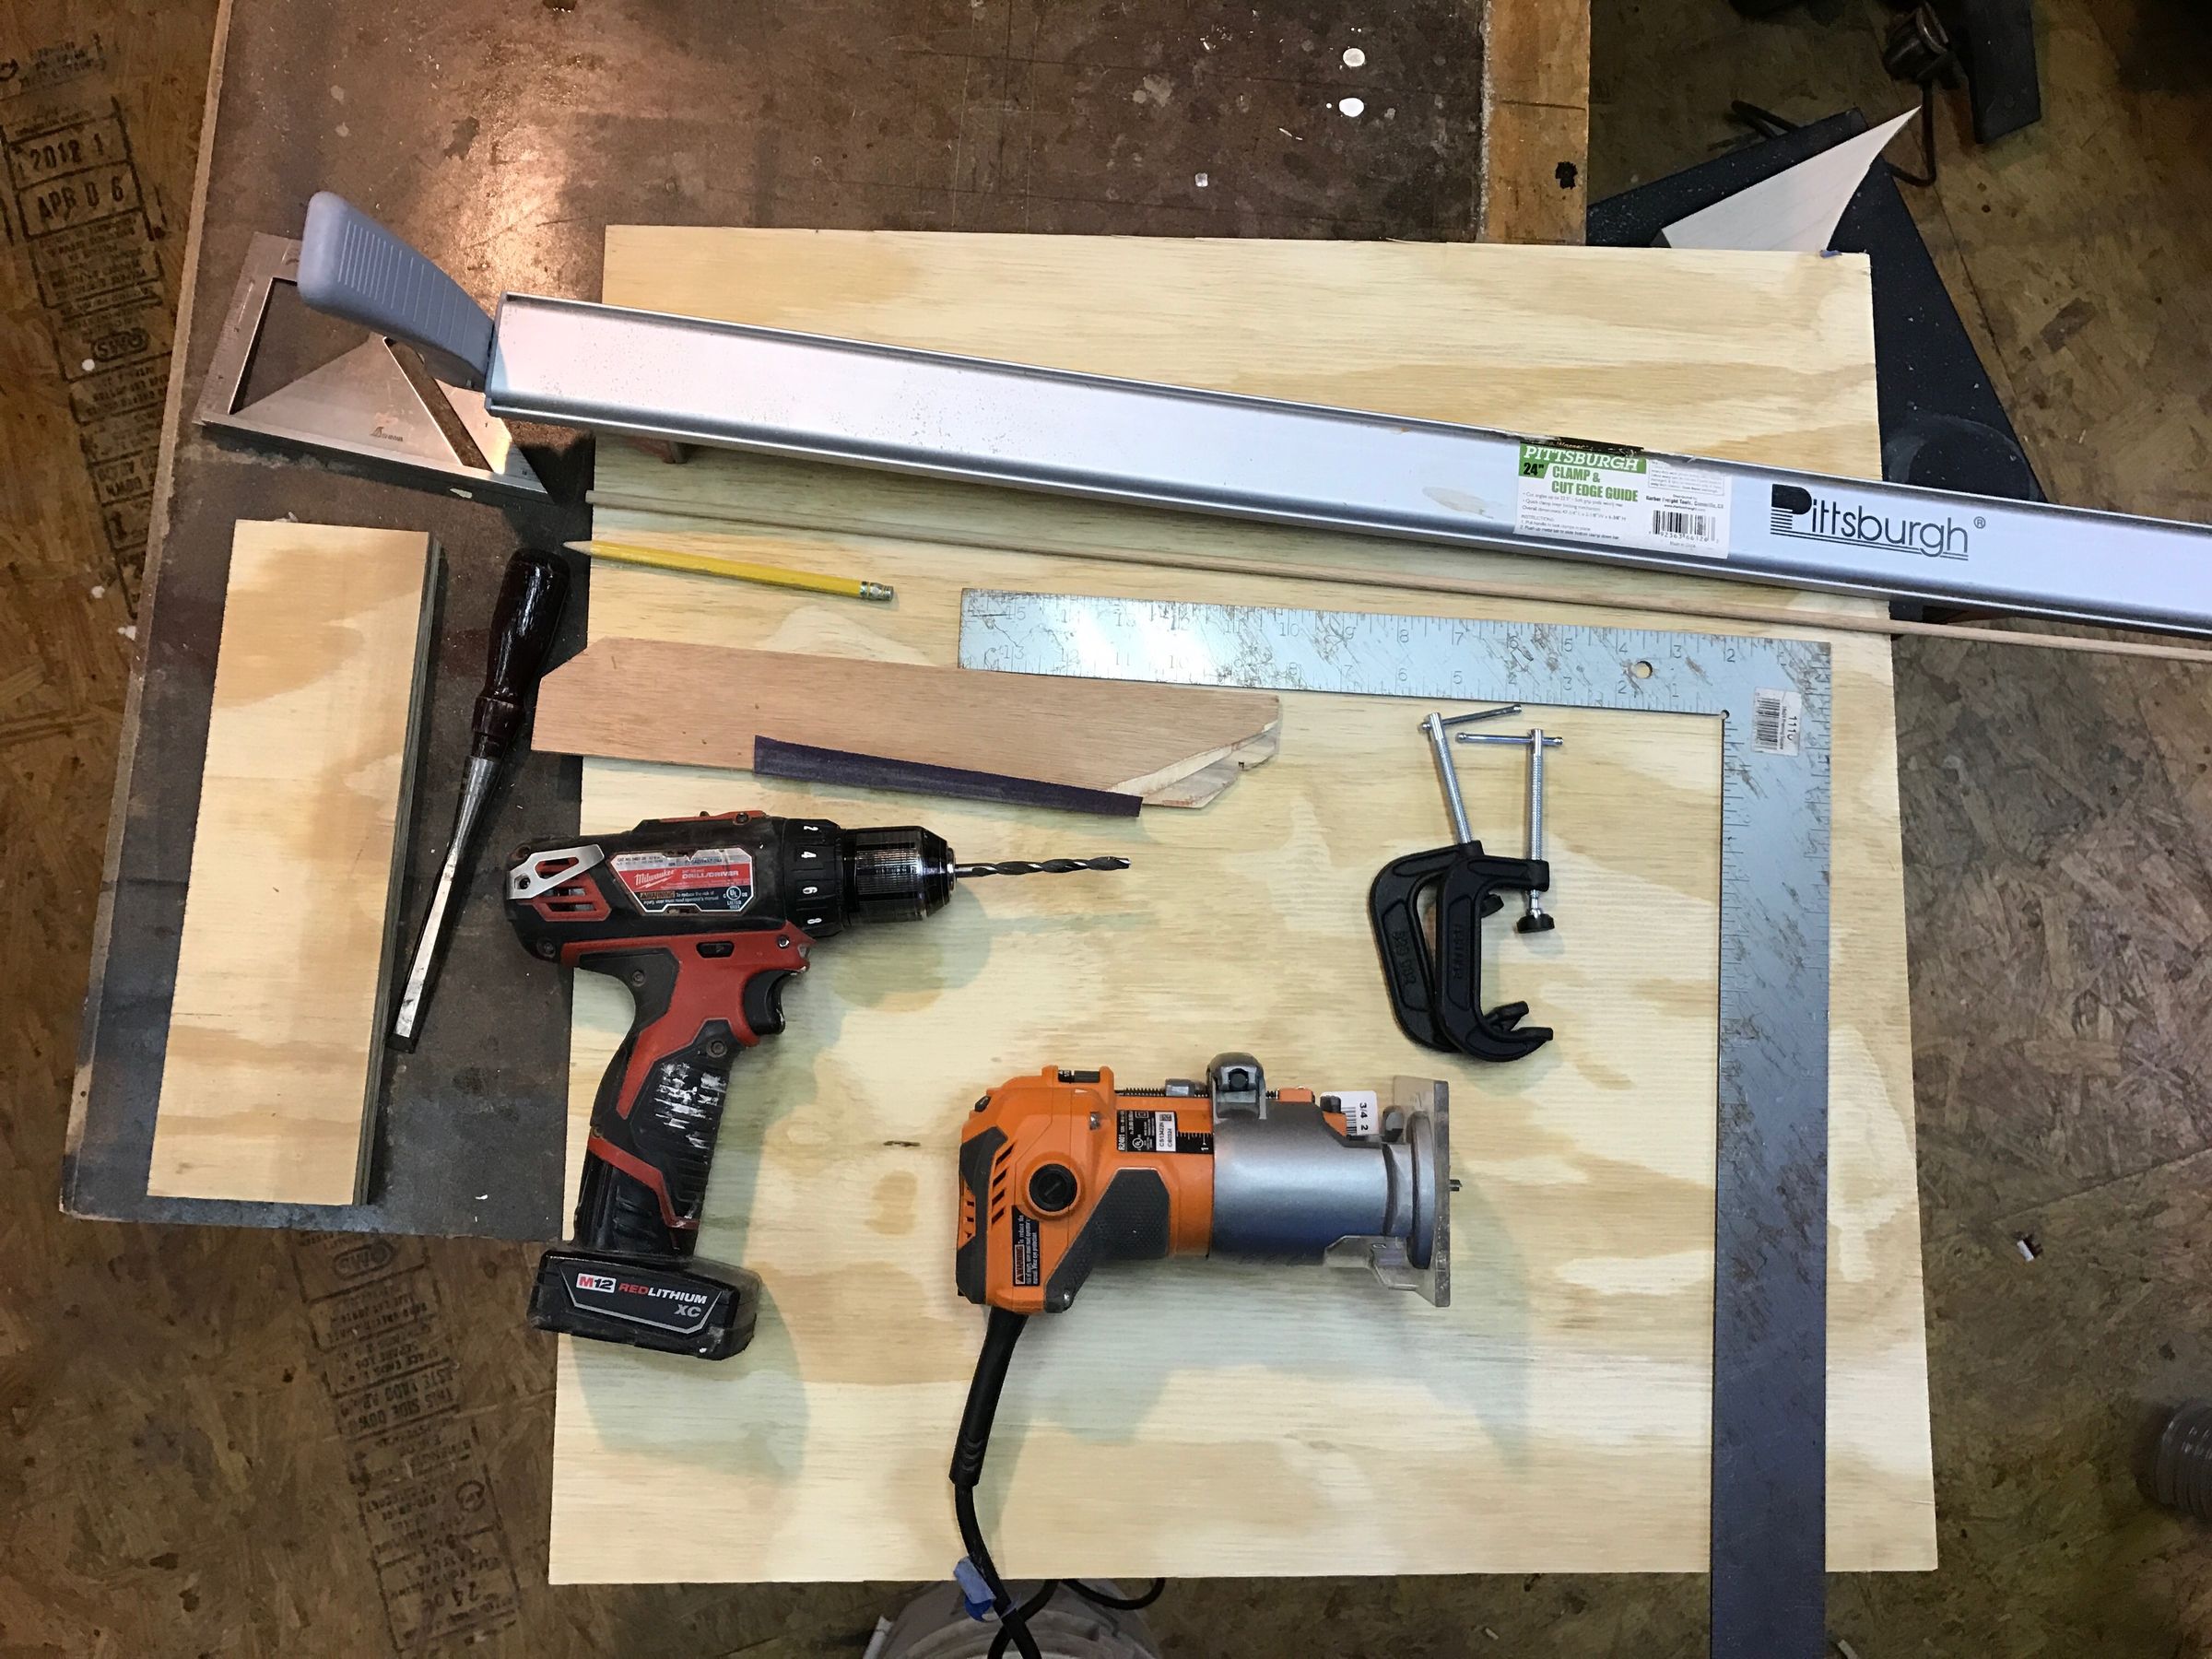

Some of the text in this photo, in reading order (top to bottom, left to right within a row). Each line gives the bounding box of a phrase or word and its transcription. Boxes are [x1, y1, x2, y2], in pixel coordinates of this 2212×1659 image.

[1524, 446, 1639, 472] PITTSBURGH
[1523, 462, 1545, 477] 24"
[1552, 465, 1601, 483] CLAMP &
[1551, 480, 1639, 502] CUT EDGE GUIDE
[1771, 483, 1969, 558] Pittsburgh
[1280, 622, 1300, 637] 10
[1399, 629, 1409, 643] 8
[1455, 631, 1465, 645] 7
[1563, 638, 1573, 653] 5
[1618, 641, 1629, 654] 4
[1674, 645, 1683, 659] 3
[1726, 649, 1736, 663] 2
[1398, 668, 1407, 681] 6
[1453, 671, 1464, 685] 5
[1563, 677, 1572, 691] 3
[1618, 681, 1628, 695] 2
[801, 851, 817, 859] 4
[634, 869, 675, 885] Milwaukee
[1359, 1102, 1368, 1119] 3/4
[1015, 1247, 1024, 1275] WARNING
[579, 1276, 614, 1290] M12
[618, 1282, 707, 1304] REDLITHIUM
[674, 1304, 702, 1317] XC
[390, 1398, 420, 1418] SIDE
